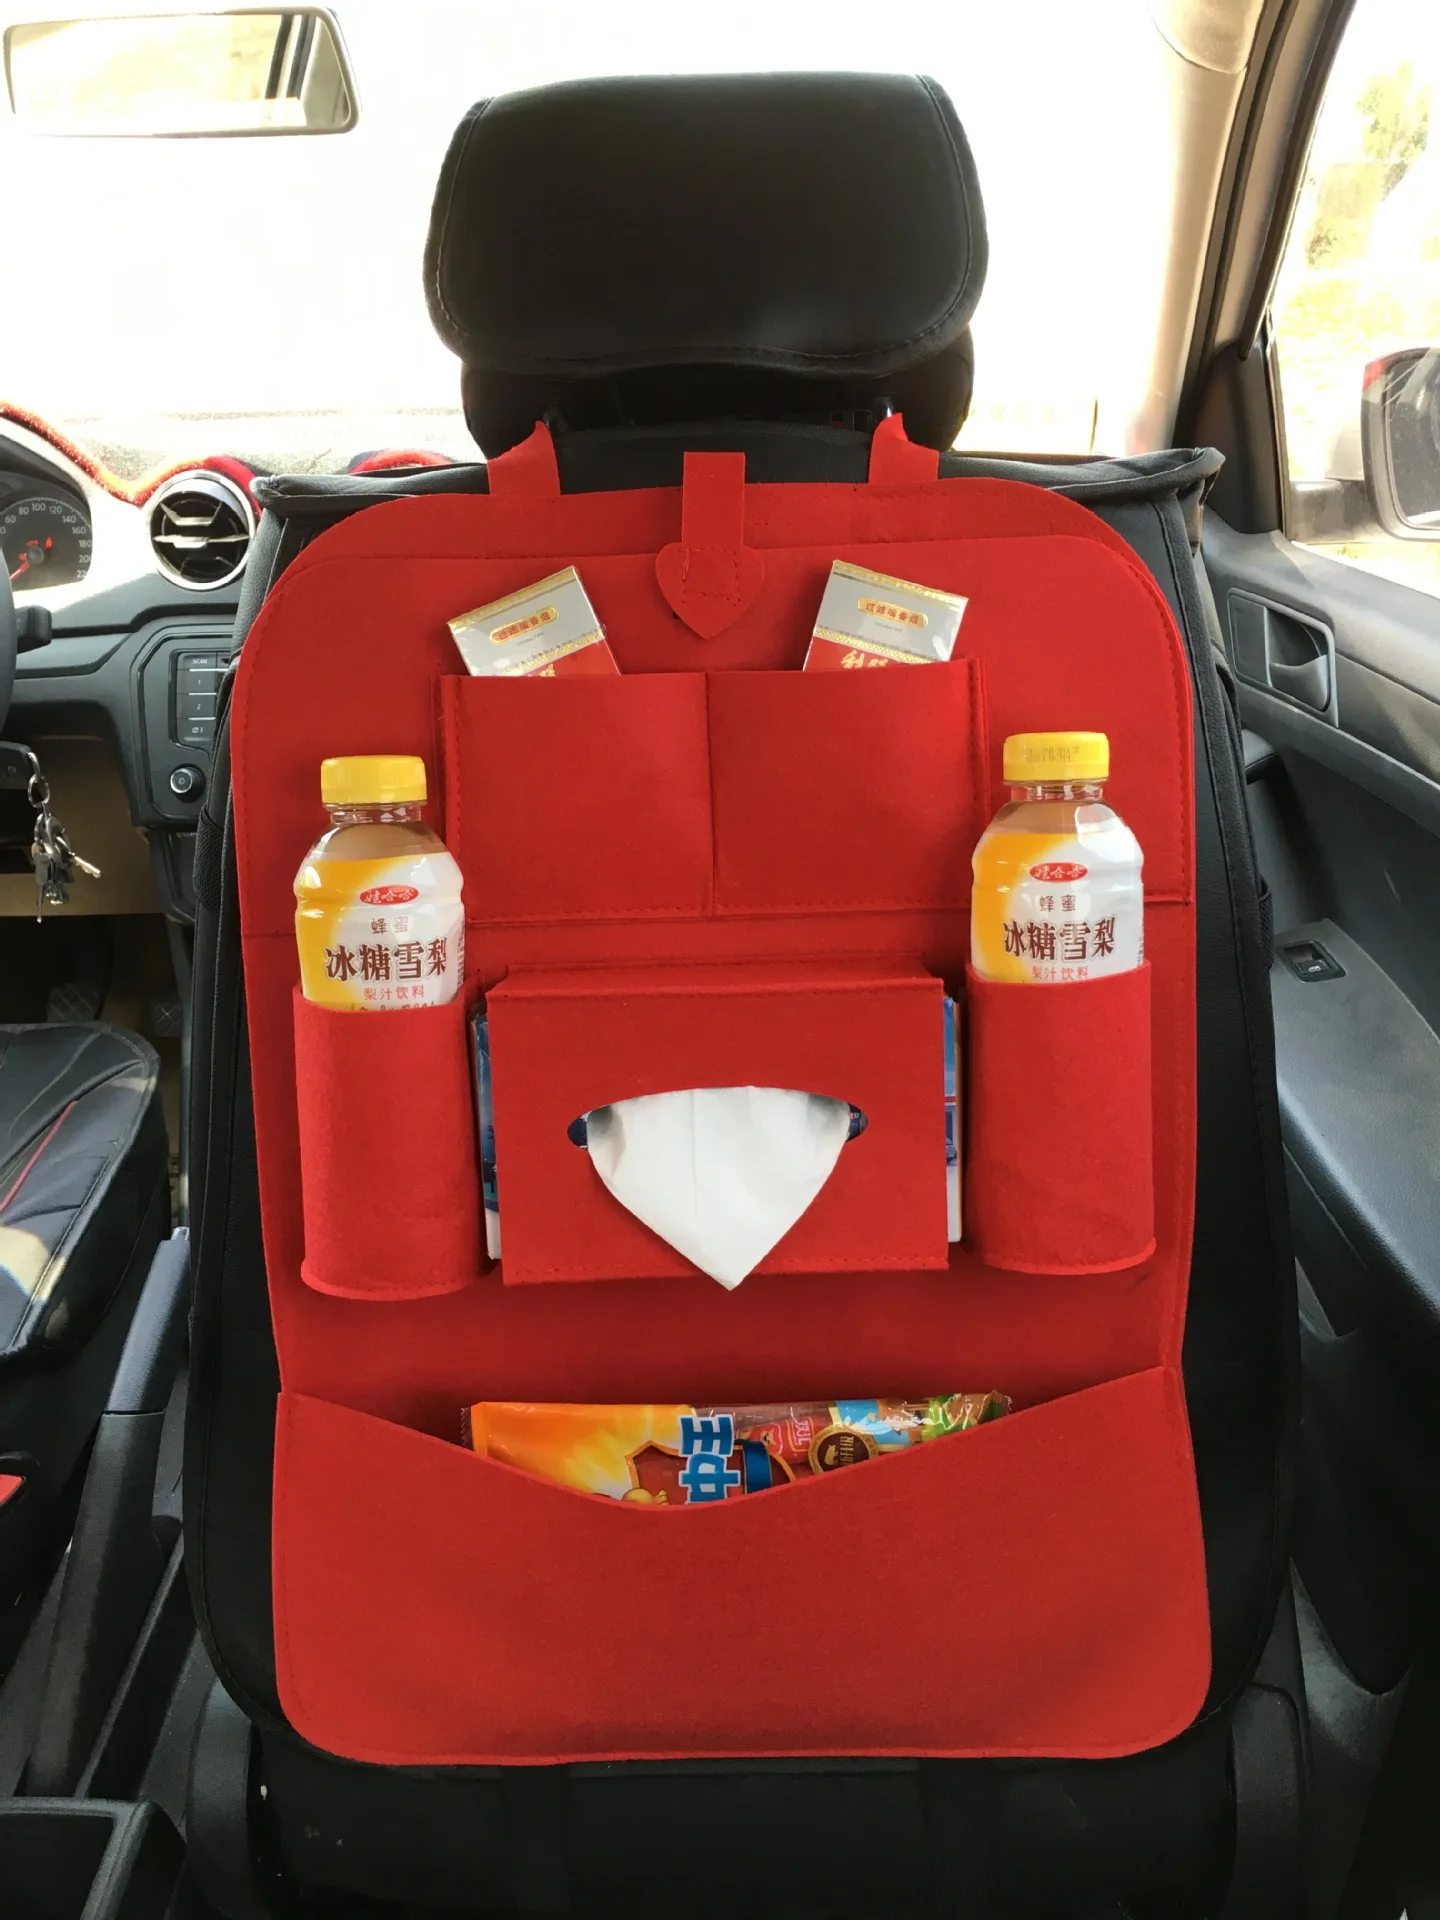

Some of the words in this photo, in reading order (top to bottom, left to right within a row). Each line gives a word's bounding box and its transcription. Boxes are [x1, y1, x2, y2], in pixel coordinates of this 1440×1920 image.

[18, 507, 29, 515] 80
[32, 503, 46, 511] 100
[49, 506, 63, 514] 120
[5, 515, 16, 523] 60
[62, 515, 77, 523] 140
[865, 602, 920, 625] 过滤嘴香烟
[1035, 865, 1083, 880] 娃哈哈
[365, 888, 415, 904] 娃哈哈
[1039, 895, 1076, 912] 蜂蜜
[371, 916, 409, 935] 蜂蜜
[1003, 916, 1116, 961] 冰糖雪梨
[325, 937, 448, 981] 冰糖雪梨
[1031, 965, 1089, 981] 梨汁饮料
[363, 984, 425, 1000] 梨汁饮料
